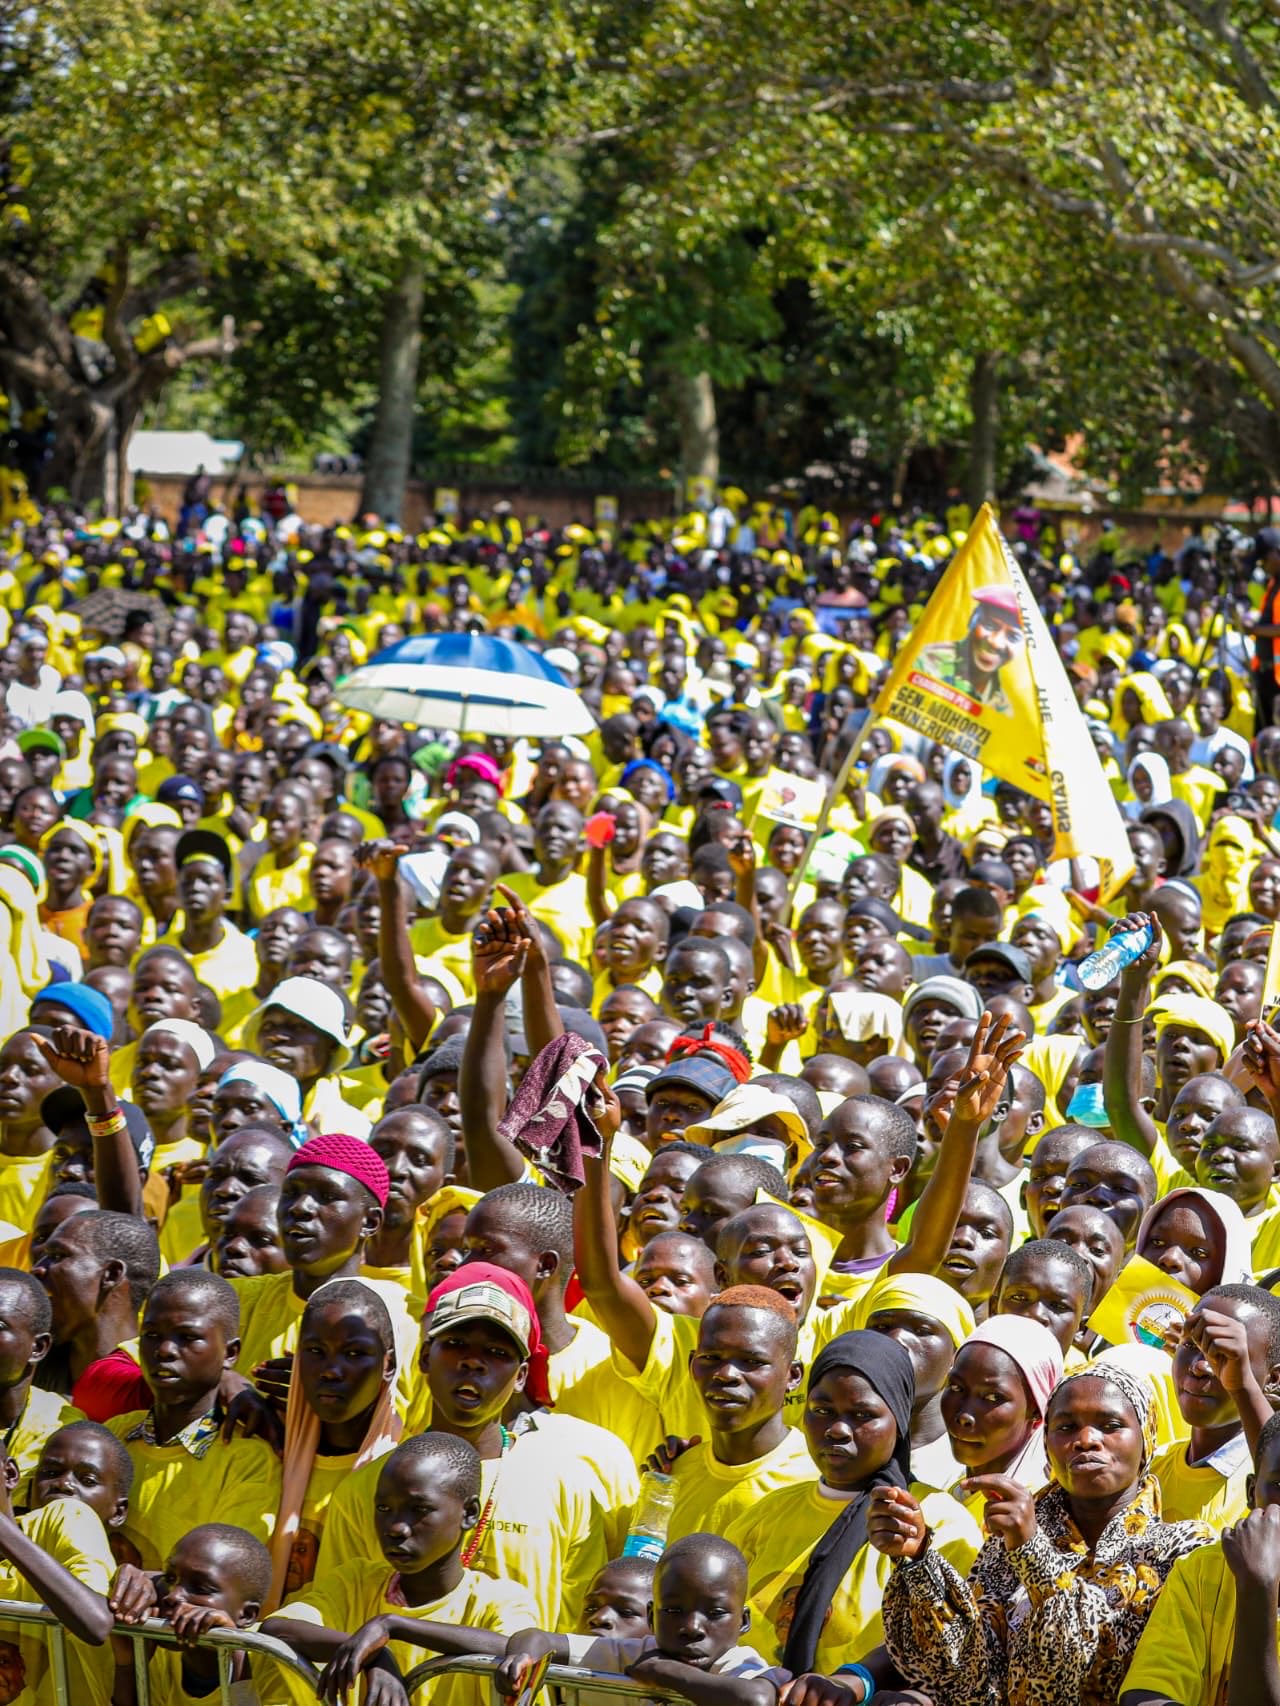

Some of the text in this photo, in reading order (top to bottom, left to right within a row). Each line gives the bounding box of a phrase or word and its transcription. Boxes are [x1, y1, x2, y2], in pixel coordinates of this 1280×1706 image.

[888, 702, 981, 760] KAINERUGABA
[896, 685, 924, 712] GEN.
[927, 701, 992, 745] MUHOOZI
[485, 1520, 528, 1534] SIDENT
